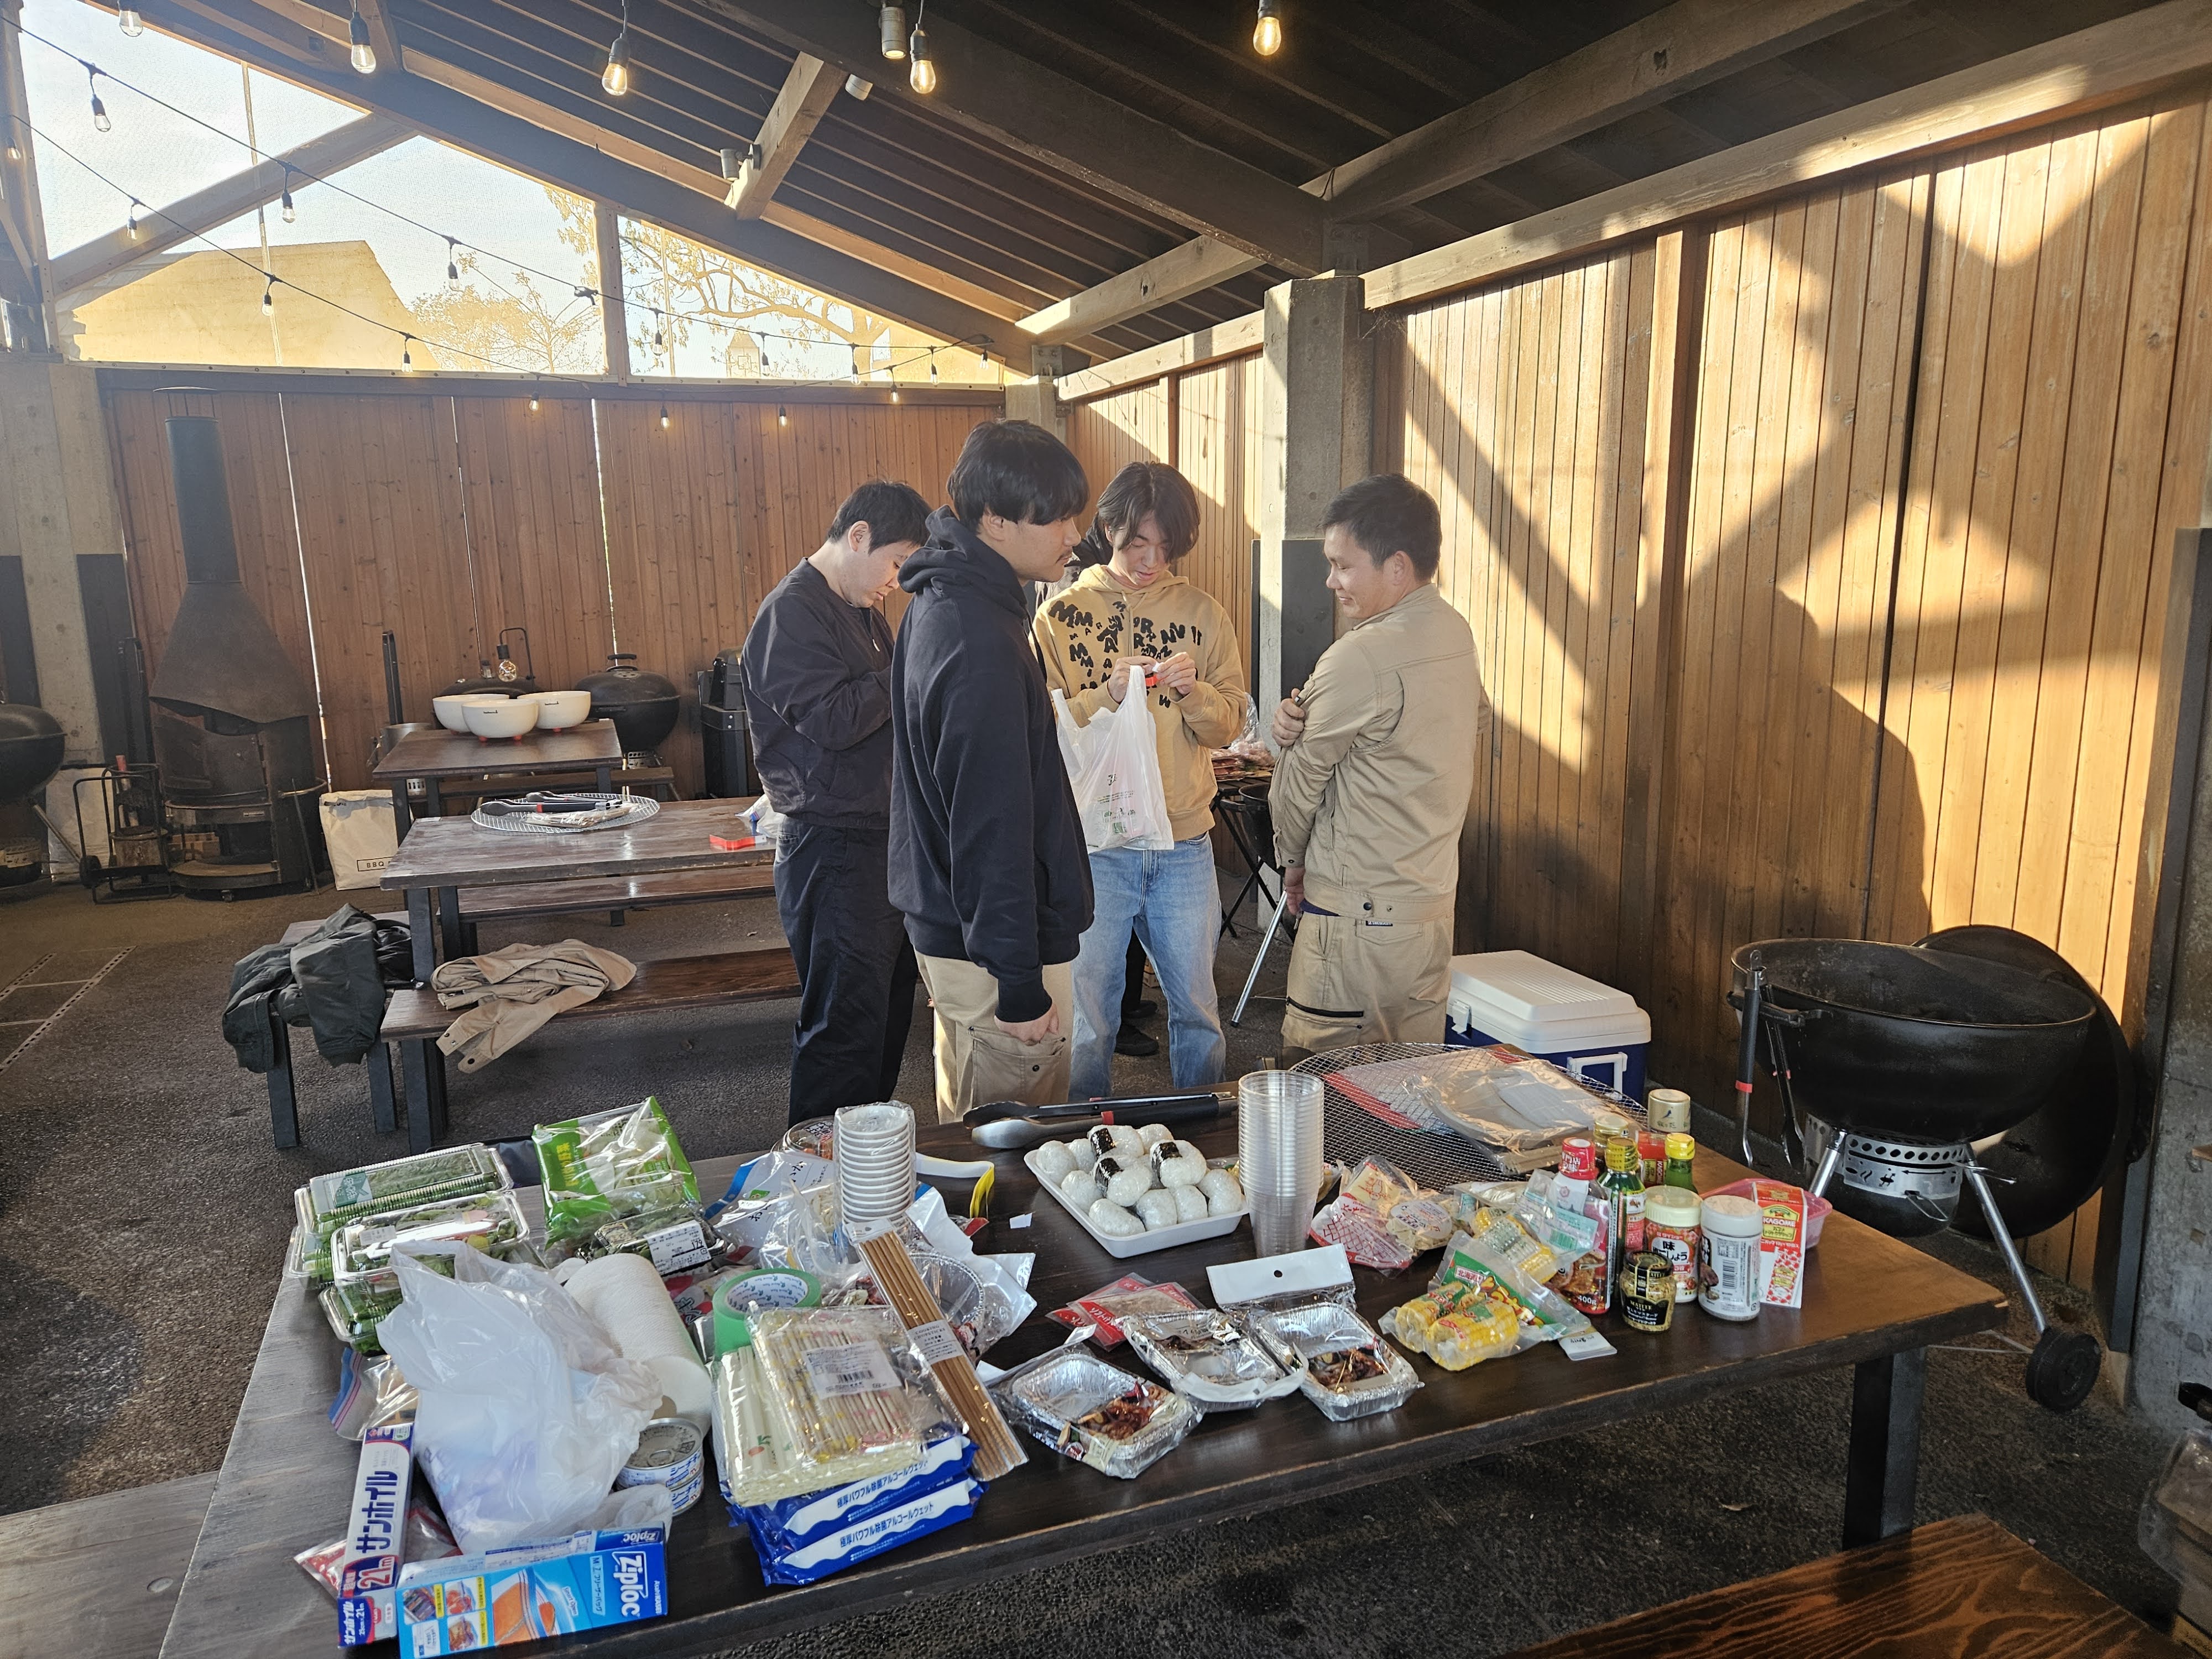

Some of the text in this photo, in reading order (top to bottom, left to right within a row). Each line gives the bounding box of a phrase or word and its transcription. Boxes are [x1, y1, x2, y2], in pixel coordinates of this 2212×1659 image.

[1763, 1217, 1796, 1227] KAGOME
[691, 1239, 702, 1250] 179
[915, 1325, 940, 1334] COOKING
[356, 1471, 398, 1553] サンホイル
[623, 1532, 656, 1545] Ziploc
[613, 1555, 643, 1616] Ziploc
